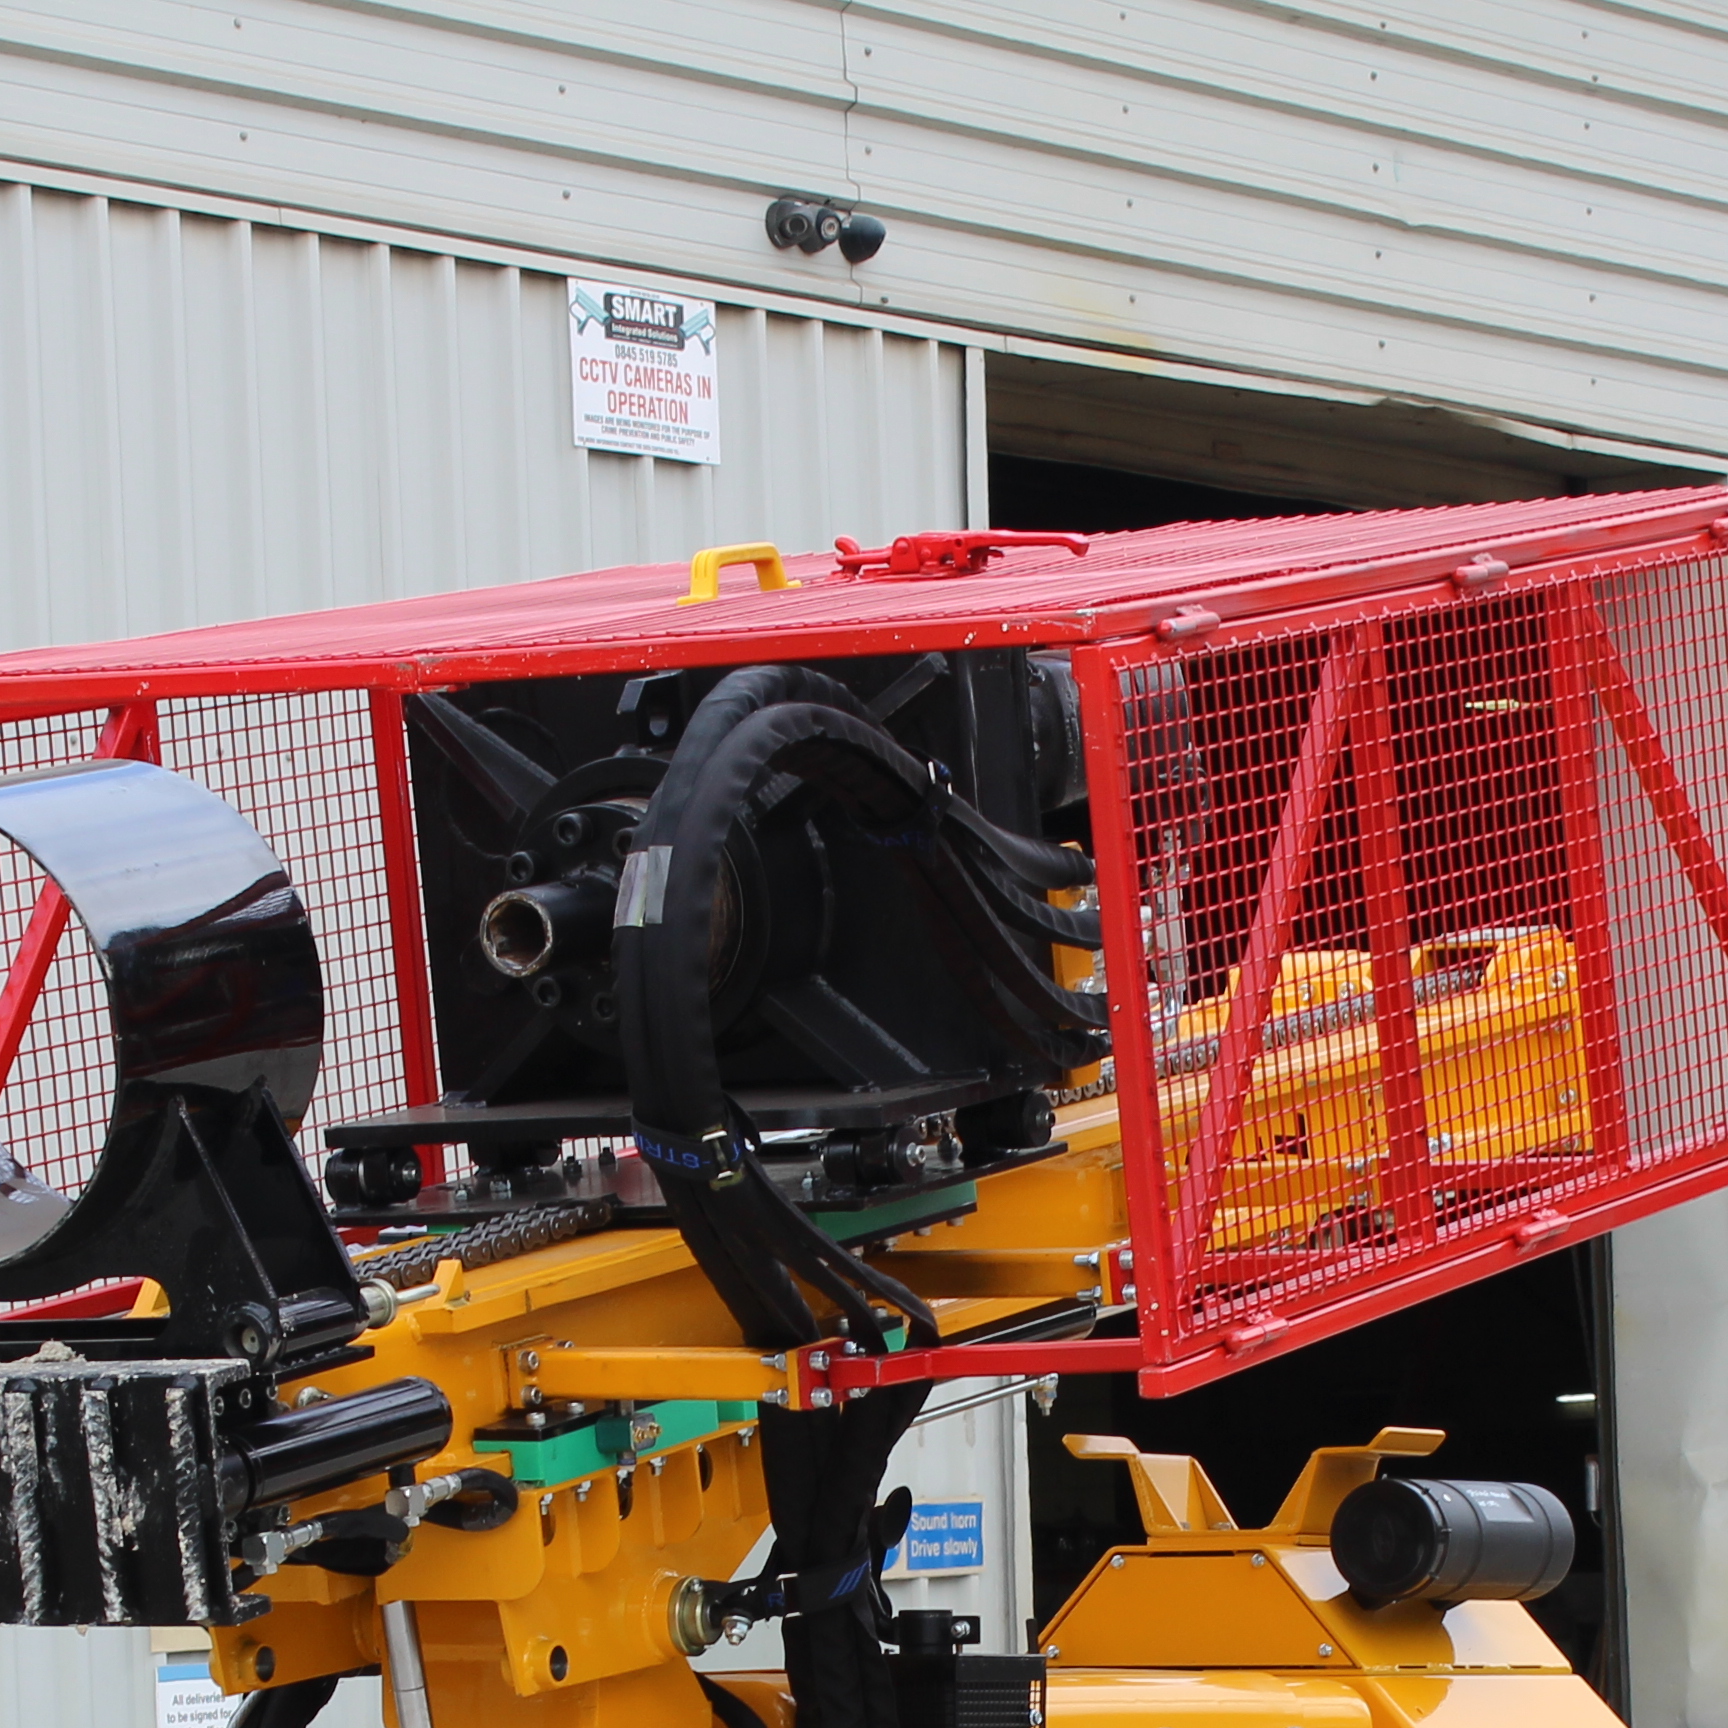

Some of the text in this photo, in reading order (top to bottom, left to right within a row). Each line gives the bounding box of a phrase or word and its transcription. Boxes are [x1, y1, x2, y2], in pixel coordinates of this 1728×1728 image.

[611, 295, 677, 328] SMART
[612, 323, 646, 337] Integrated
[647, 328, 678, 343] Solutions
[615, 344, 678, 369] 0845 519 5785
[579, 357, 712, 400] CCTV CAMERAS IN
[607, 389, 689, 425] OPERATION
[911, 1511, 977, 1532] Sound horn
[911, 1538, 978, 1560] Drive slowly
[172, 1690, 226, 1706] All deliveries
[167, 1707, 232, 1724] to be signed for
